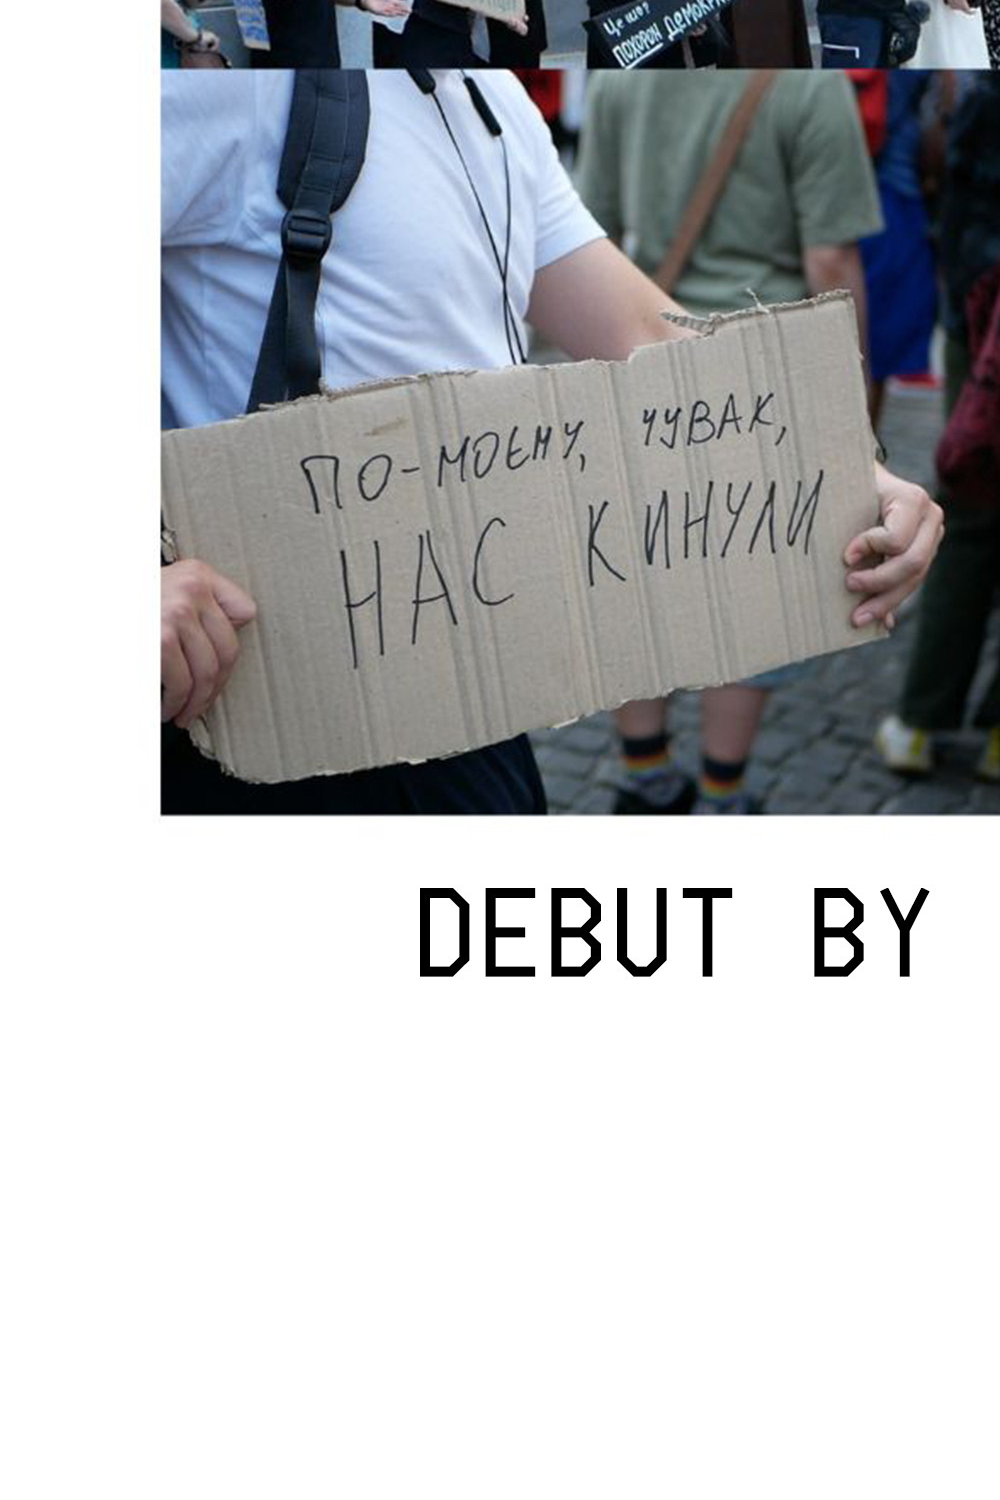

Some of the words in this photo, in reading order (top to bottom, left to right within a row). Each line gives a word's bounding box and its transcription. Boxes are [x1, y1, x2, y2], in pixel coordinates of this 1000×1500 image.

[612, 22, 663, 68] ПОХОРОН
[641, 392, 787, 449] ЧУВАК,
[340, 516, 514, 669] НАС
[587, 469, 825, 587] КИНУЛИ
